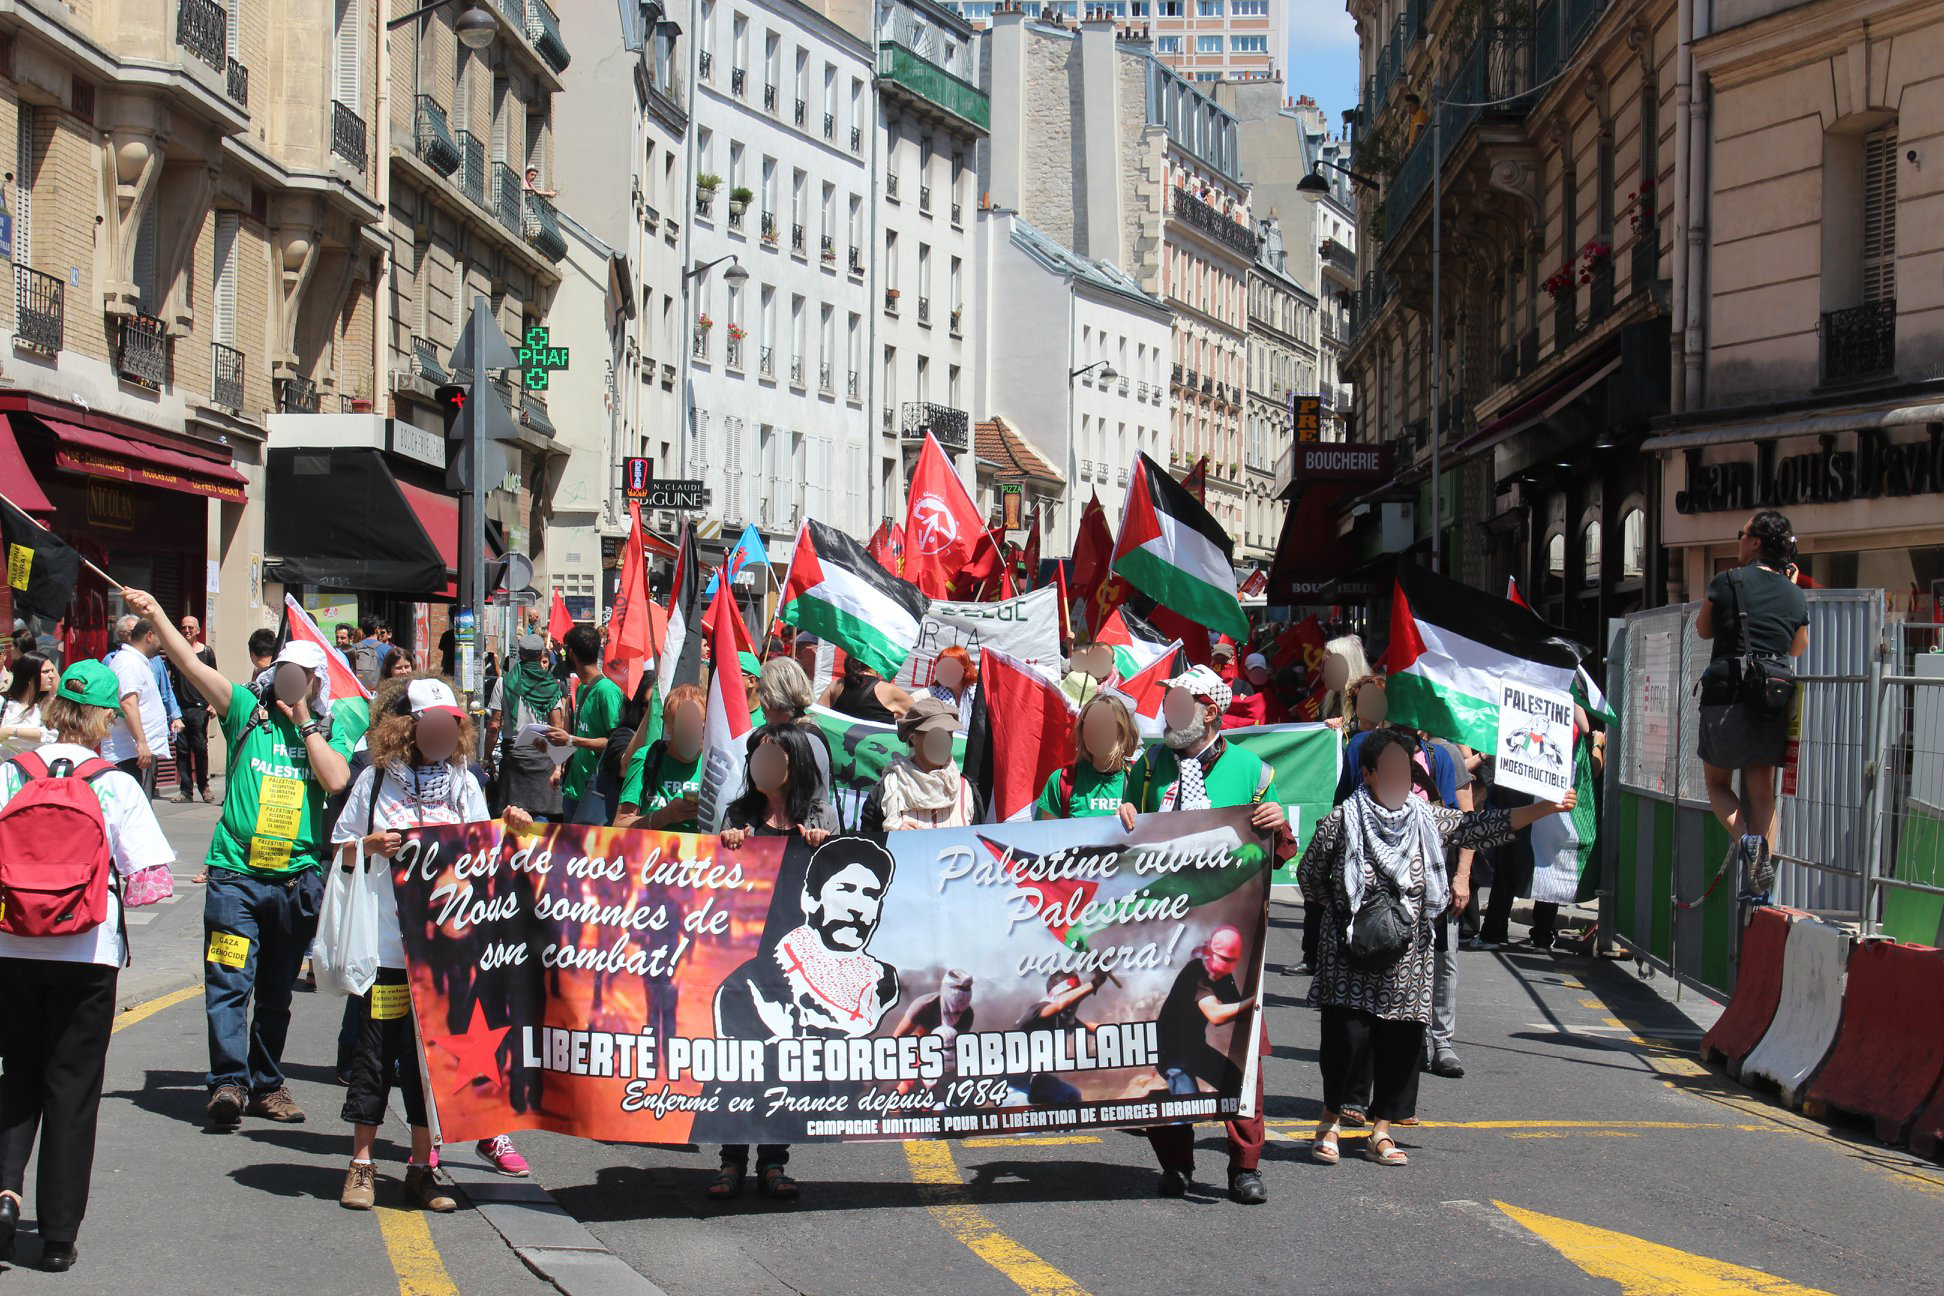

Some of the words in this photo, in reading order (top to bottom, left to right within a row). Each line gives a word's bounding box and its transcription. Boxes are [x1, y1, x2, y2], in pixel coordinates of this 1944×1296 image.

[1306, 452, 1379, 470] BOUCHERIE
[1676, 449, 1754, 514] Jean
[1754, 433, 1853, 507] Louis
[90, 487, 132, 520] NICOLAS
[1003, 484, 1023, 493] PIZZA
[10, 546, 21, 586] PALESTINE
[1504, 687, 1571, 727] PALESTINE
[273, 743, 306, 759] FREE
[268, 777, 297, 786] PALESTINE
[664, 780, 700, 794] FREE
[1500, 757, 1568, 790] INDESTRUCTIBLE!
[266, 807, 293, 815] PALESTINE
[257, 838, 285, 847] PALESTINE
[395, 838, 440, 882] Il
[455, 838, 503, 879] est
[510, 836, 554, 875] de
[566, 852, 626, 882] nos
[641, 846, 755, 893] luttes,
[935, 844, 1120, 894] Palestine
[1134, 840, 1245, 875] vivra,
[430, 883, 519, 932] Nous
[534, 892, 670, 933] sommes
[683, 896, 730, 935] de
[1004, 886, 1191, 936] Palestine
[219, 936, 239, 947] GAZA
[478, 935, 528, 972] son
[541, 932, 690, 978] combat!
[1015, 922, 1187, 978] vaincra!
[522, 1025, 657, 1080] LIBERTÉ
[668, 1038, 766, 1082] POUR
[778, 1035, 944, 1082] GEORGES
[956, 1021, 1160, 1078] ABDALLAH!
[620, 1079, 722, 1120] Enfermé
[728, 1093, 756, 1113] en
[764, 1086, 849, 1118] France
[858, 1086, 936, 1117] depuis
[945, 1078, 1009, 1108] 1984
[806, 1118, 879, 1136] CAMPAGNE
[882, 1117, 942, 1134] UNITAIRE
[944, 1115, 980, 1132] POUR
[982, 1113, 999, 1130] LA
[1002, 1108, 1077, 1130] LIBÉRATION
[1080, 1107, 1097, 1123] DE
[1100, 1102, 1158, 1122] GEORGES
[1161, 1098, 1217, 1117] IBRAHIM
[1221, 1097, 1241, 1114] AB
